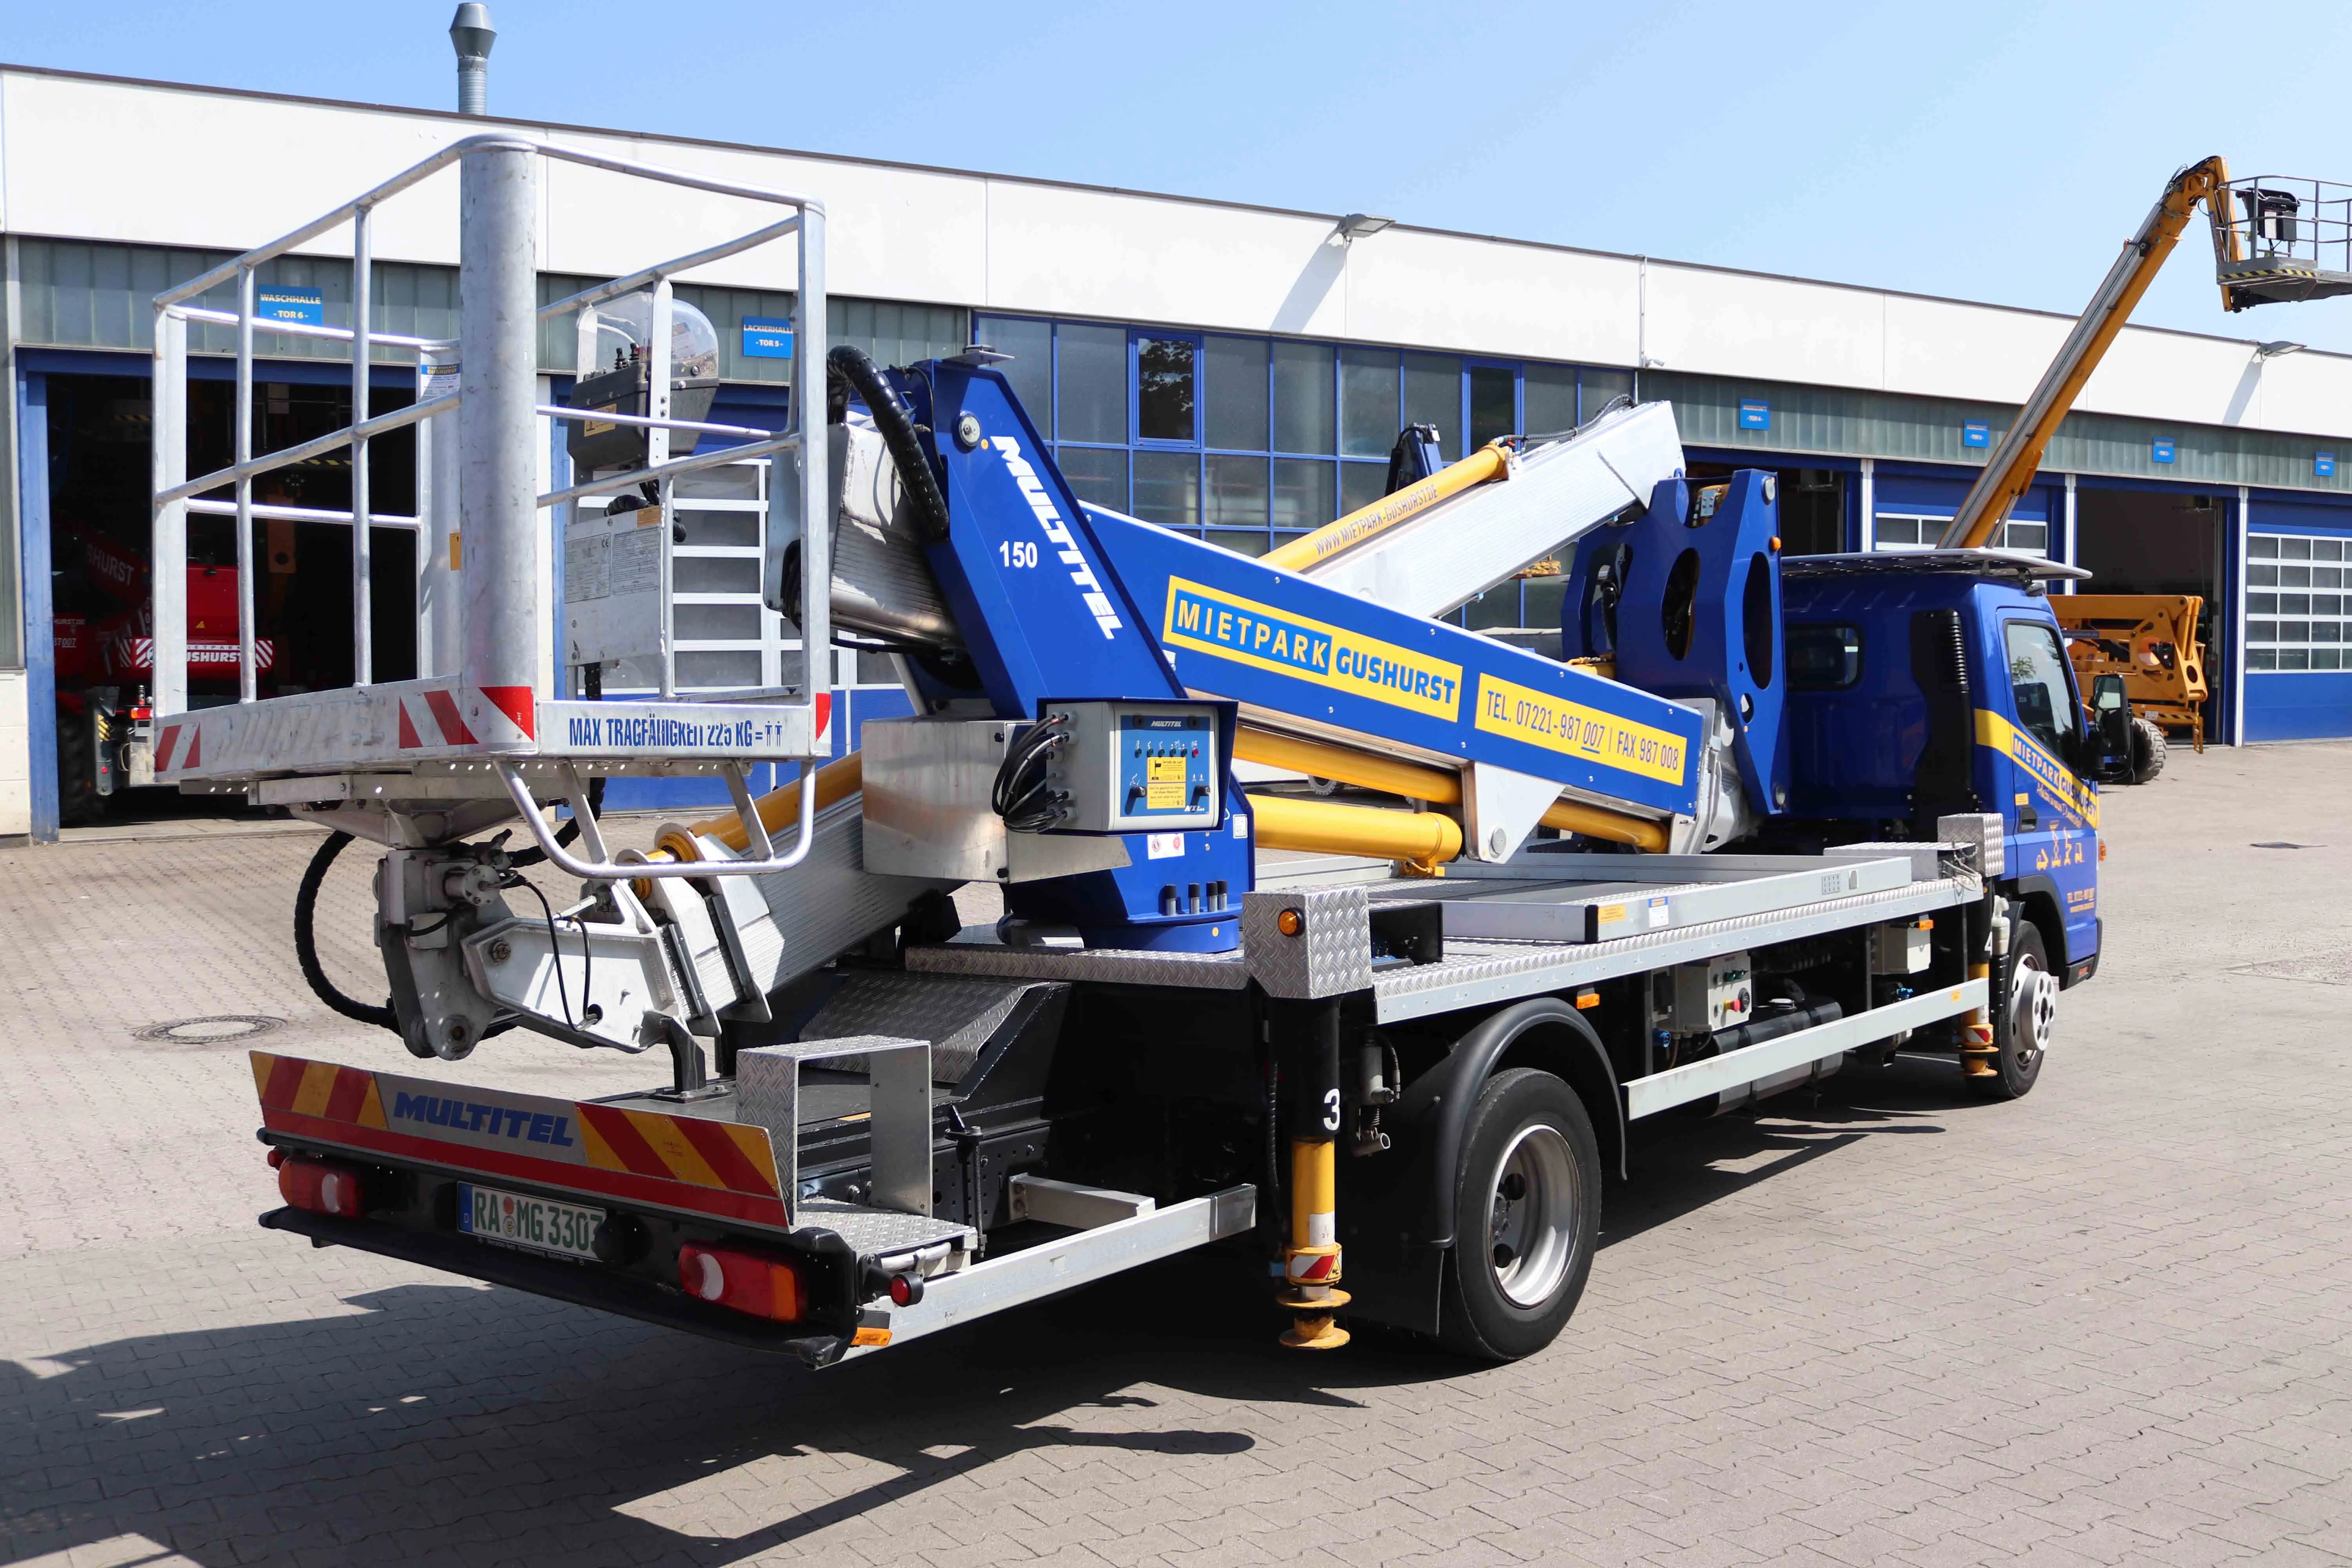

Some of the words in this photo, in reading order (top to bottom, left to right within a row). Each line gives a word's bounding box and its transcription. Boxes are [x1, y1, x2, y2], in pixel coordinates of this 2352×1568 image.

[260, 294, 321, 304] WASCHHALLE
[989, 436, 1123, 639] MULTITEL
[1314, 484, 1438, 556] WWW.MIETPARK-GUSHURST.DE
[999, 541, 1038, 568] 150
[1177, 599, 1328, 668] MIETPARK
[1336, 646, 1456, 704] GUSHURST
[570, 718, 602, 746] MAX
[736, 720, 753, 747] KG
[1487, 690, 1511, 722] TEL.
[1617, 731, 1635, 759] FAX
[1639, 738, 1659, 764] 987
[1660, 744, 1679, 770] 008
[2014, 738, 2059, 788] MIETPARK
[1984, 931, 1993, 956] 4
[394, 1092, 573, 1147] MULTITEL
[1323, 1088, 1340, 1131] 3
[474, 1192, 500, 1232] RA
[517, 1200, 543, 1242] MG
